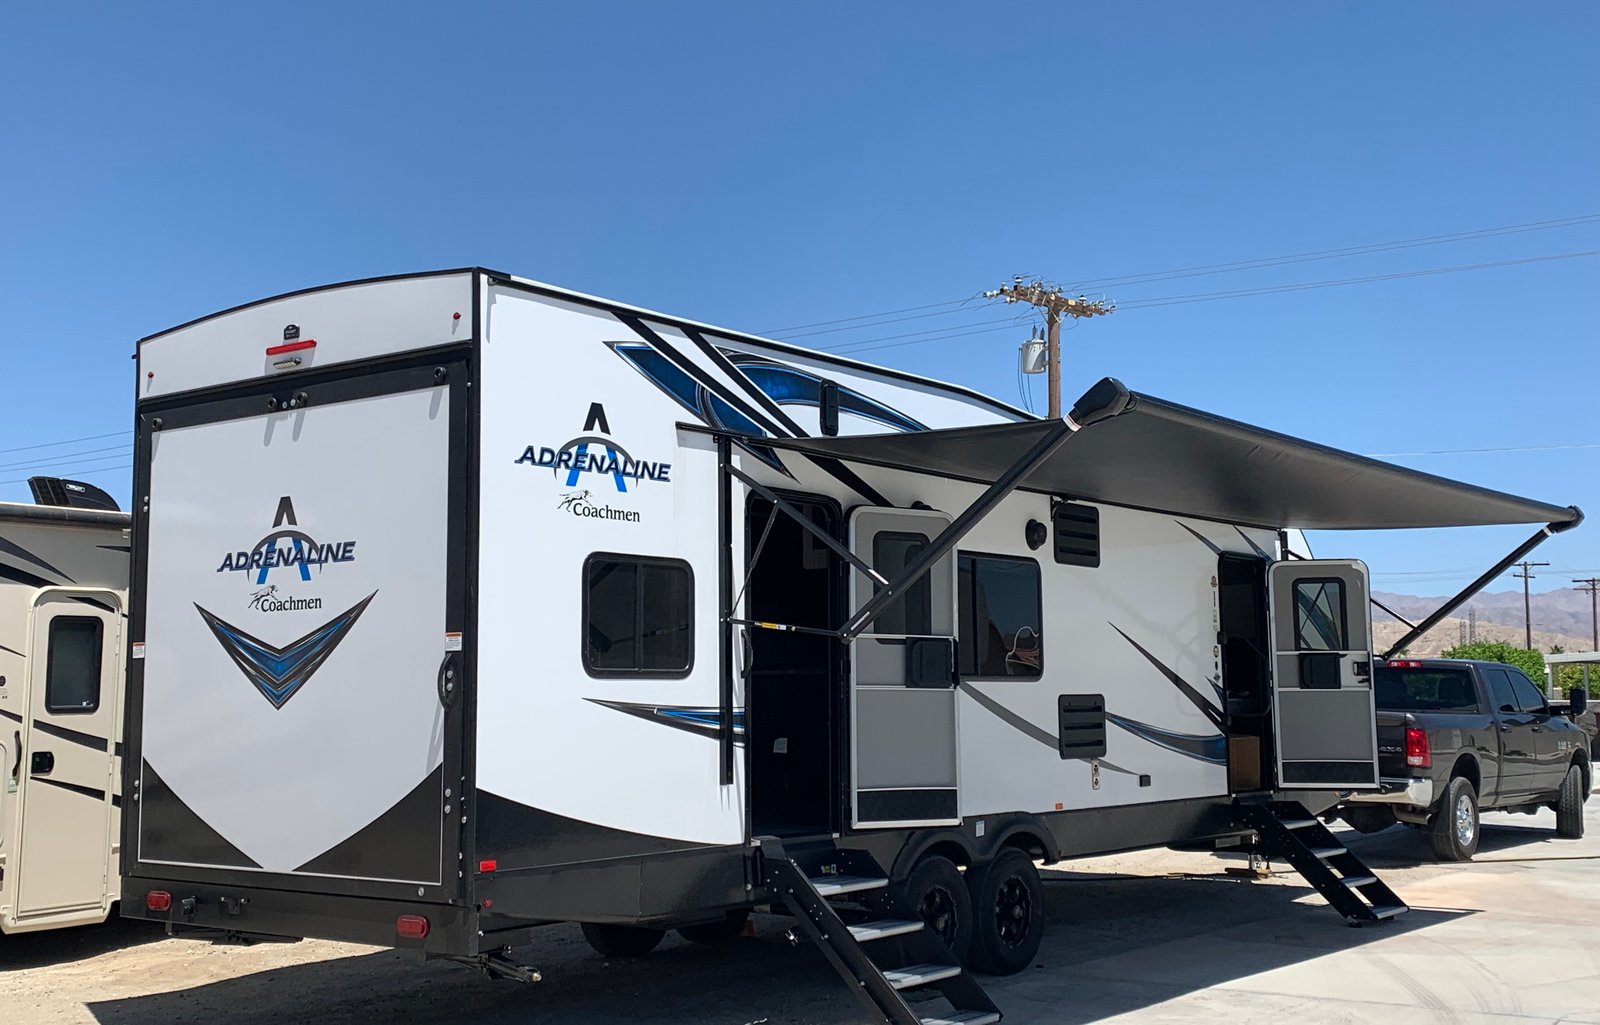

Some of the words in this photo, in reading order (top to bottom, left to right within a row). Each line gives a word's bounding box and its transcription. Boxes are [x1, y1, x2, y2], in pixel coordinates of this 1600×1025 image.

[514, 445, 671, 482] ADRENALINE
[573, 502, 640, 522] Coachmen
[216, 541, 356, 573] ADRENALINE
[261, 596, 322, 612] Coachmen
